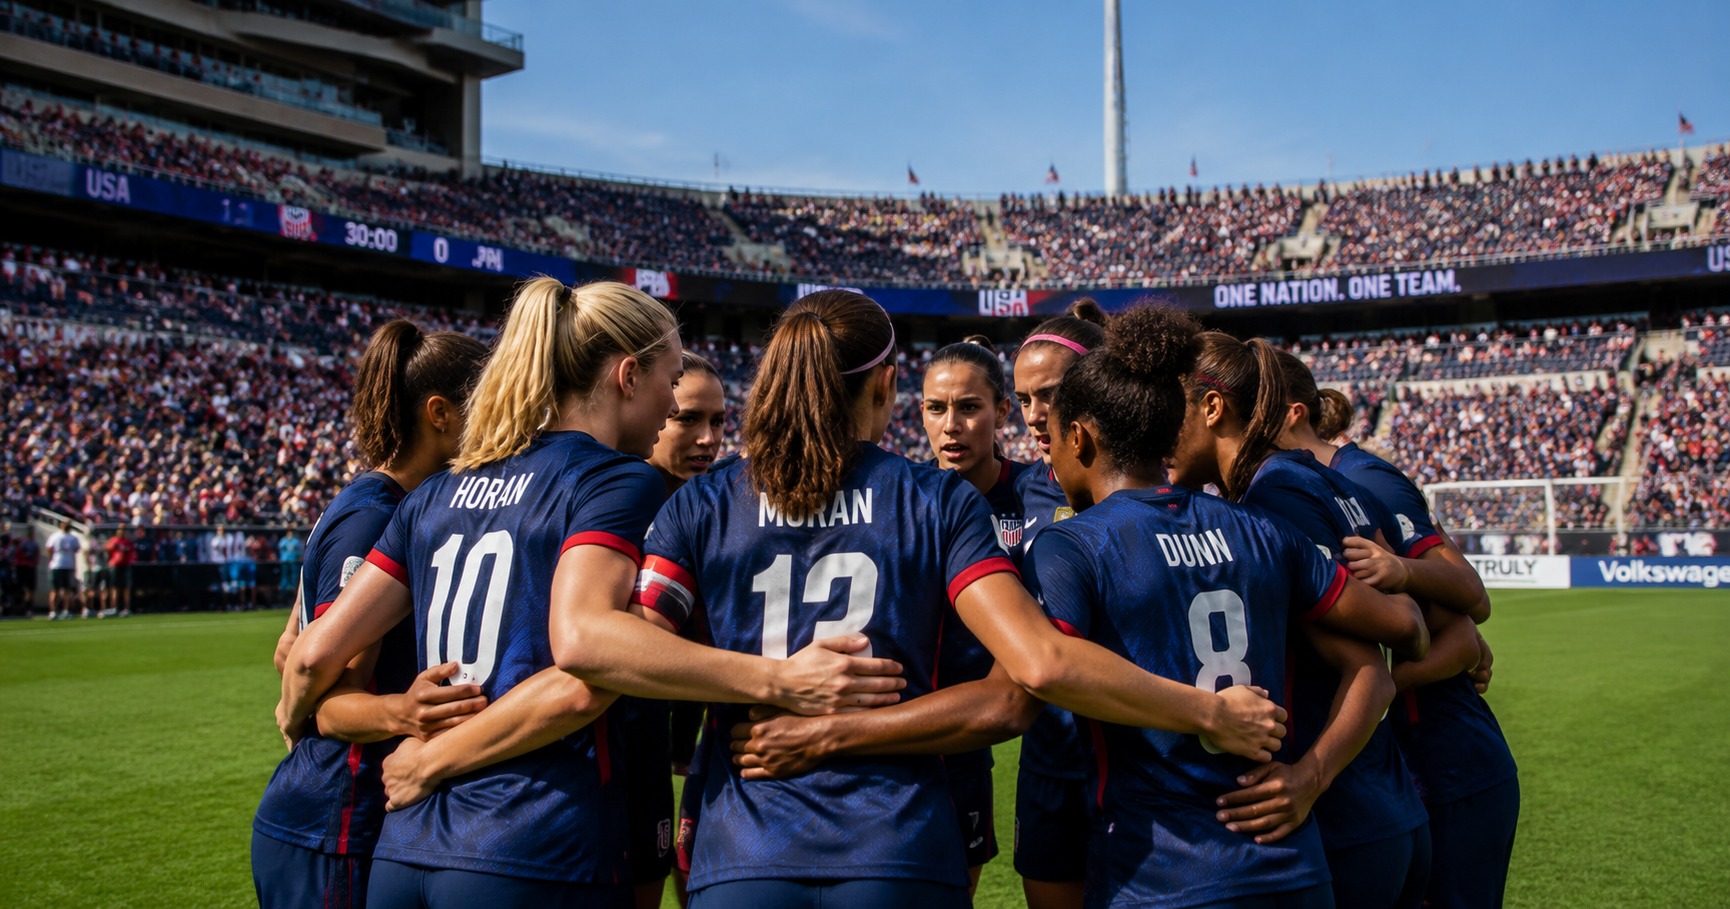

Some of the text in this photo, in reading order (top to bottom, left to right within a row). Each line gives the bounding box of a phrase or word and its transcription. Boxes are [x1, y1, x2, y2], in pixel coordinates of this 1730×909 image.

[86, 168, 130, 203] USA
[345, 222, 398, 252] 30:00
[434, 237, 449, 263] 0
[1214, 269, 1461, 308] ONE NATION. ONE TEAM.
[449, 472, 534, 510] HORAN
[1155, 528, 1234, 567] DUNN
[1473, 559, 1537, 576] TRULY
[426, 530, 514, 687] 10
[1188, 589, 1251, 754] 8
